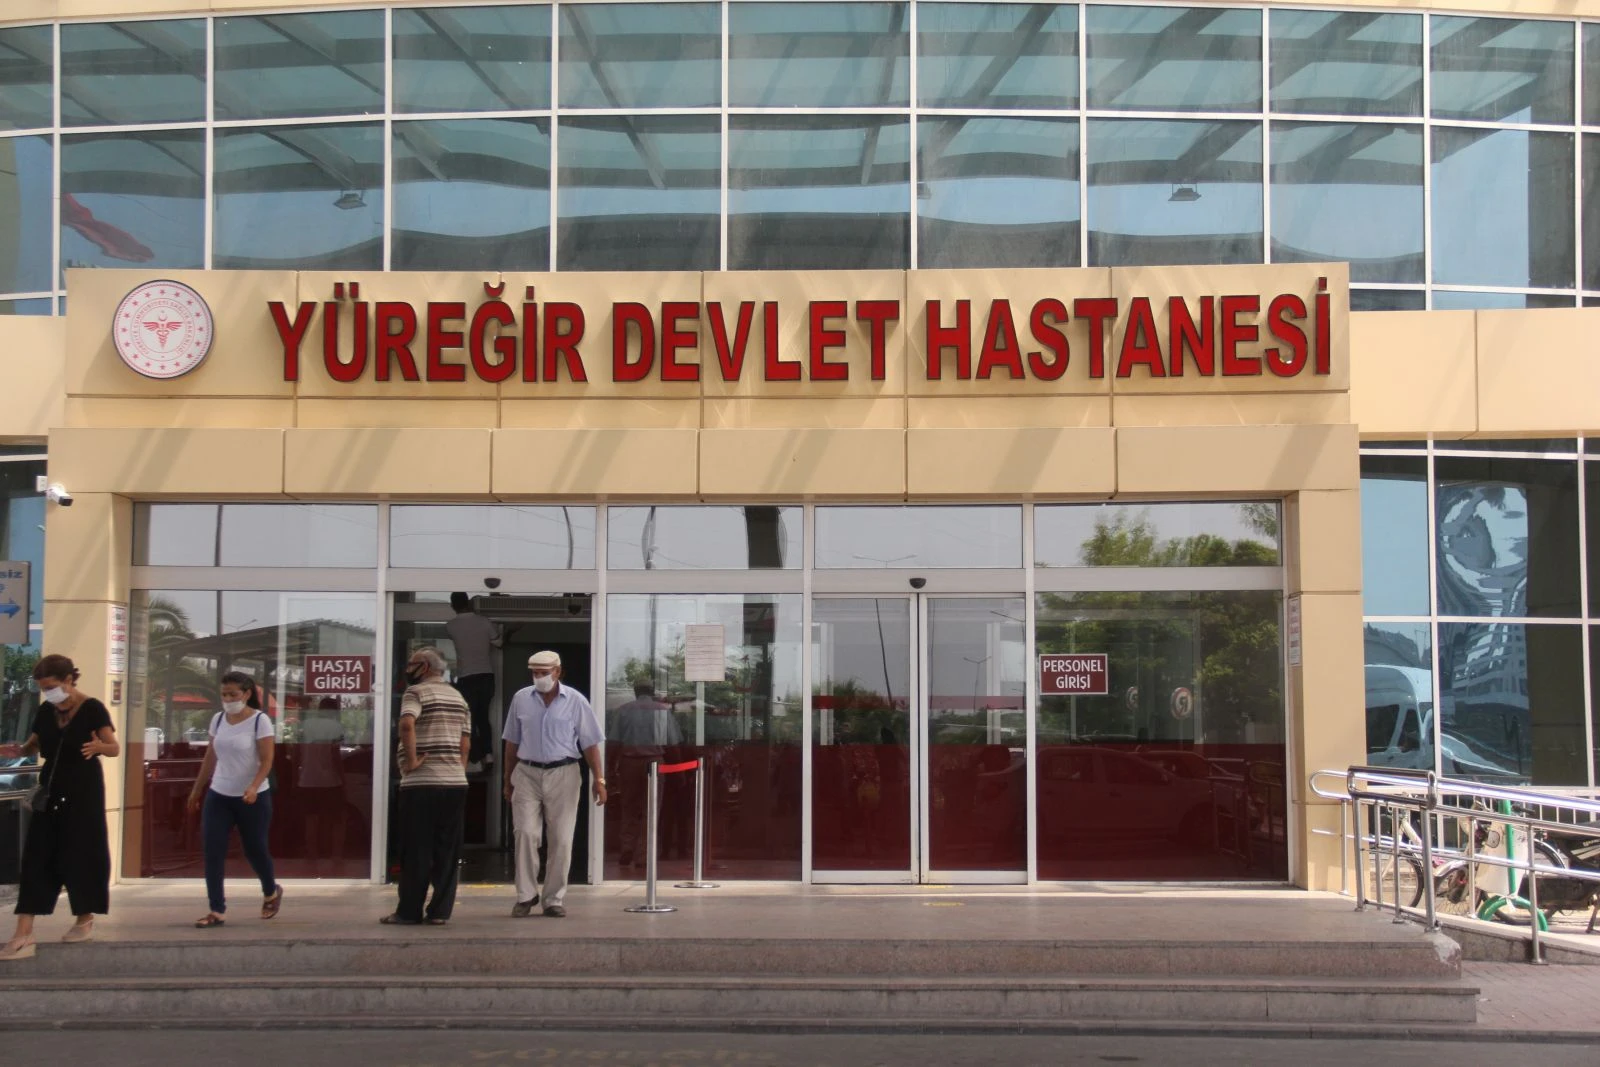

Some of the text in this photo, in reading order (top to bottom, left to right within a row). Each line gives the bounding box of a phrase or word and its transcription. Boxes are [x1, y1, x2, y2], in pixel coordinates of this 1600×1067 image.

[268, 277, 1330, 382] YÜREĞİR DEVLET HASTANESİ
[312, 660, 364, 673] HASTA
[1043, 659, 1104, 673] PERSONEL
[314, 674, 361, 690] GİRİŞİ
[1056, 674, 1091, 690] GİRİŞİ
